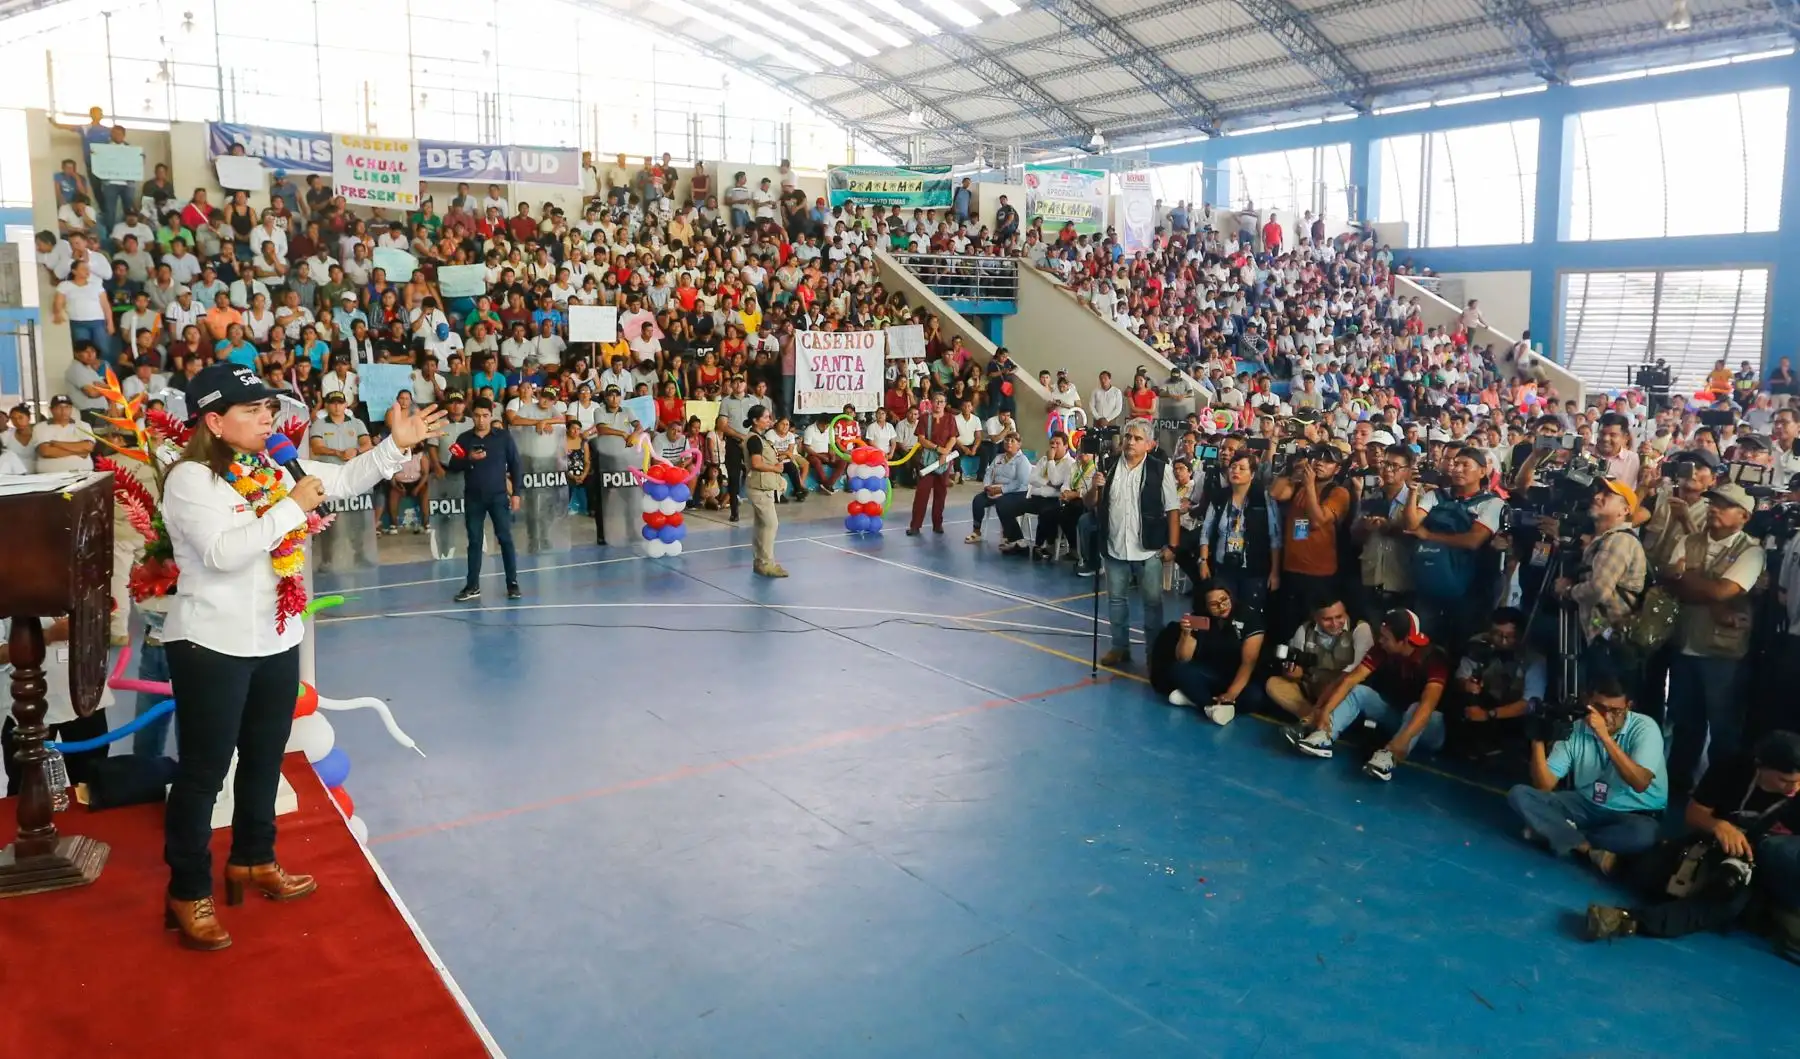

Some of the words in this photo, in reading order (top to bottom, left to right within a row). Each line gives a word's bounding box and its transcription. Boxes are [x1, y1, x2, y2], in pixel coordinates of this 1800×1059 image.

[345, 154, 408, 172] ACHUAL
[427, 149, 463, 169] DE
[468, 150, 560, 174] SALUD
[801, 333, 874, 350] CASERIO
[811, 355, 865, 373] SANTA
[814, 373, 864, 391] LUCIA
[522, 471, 568, 488] OLICIA
[429, 499, 465, 515] POLI
